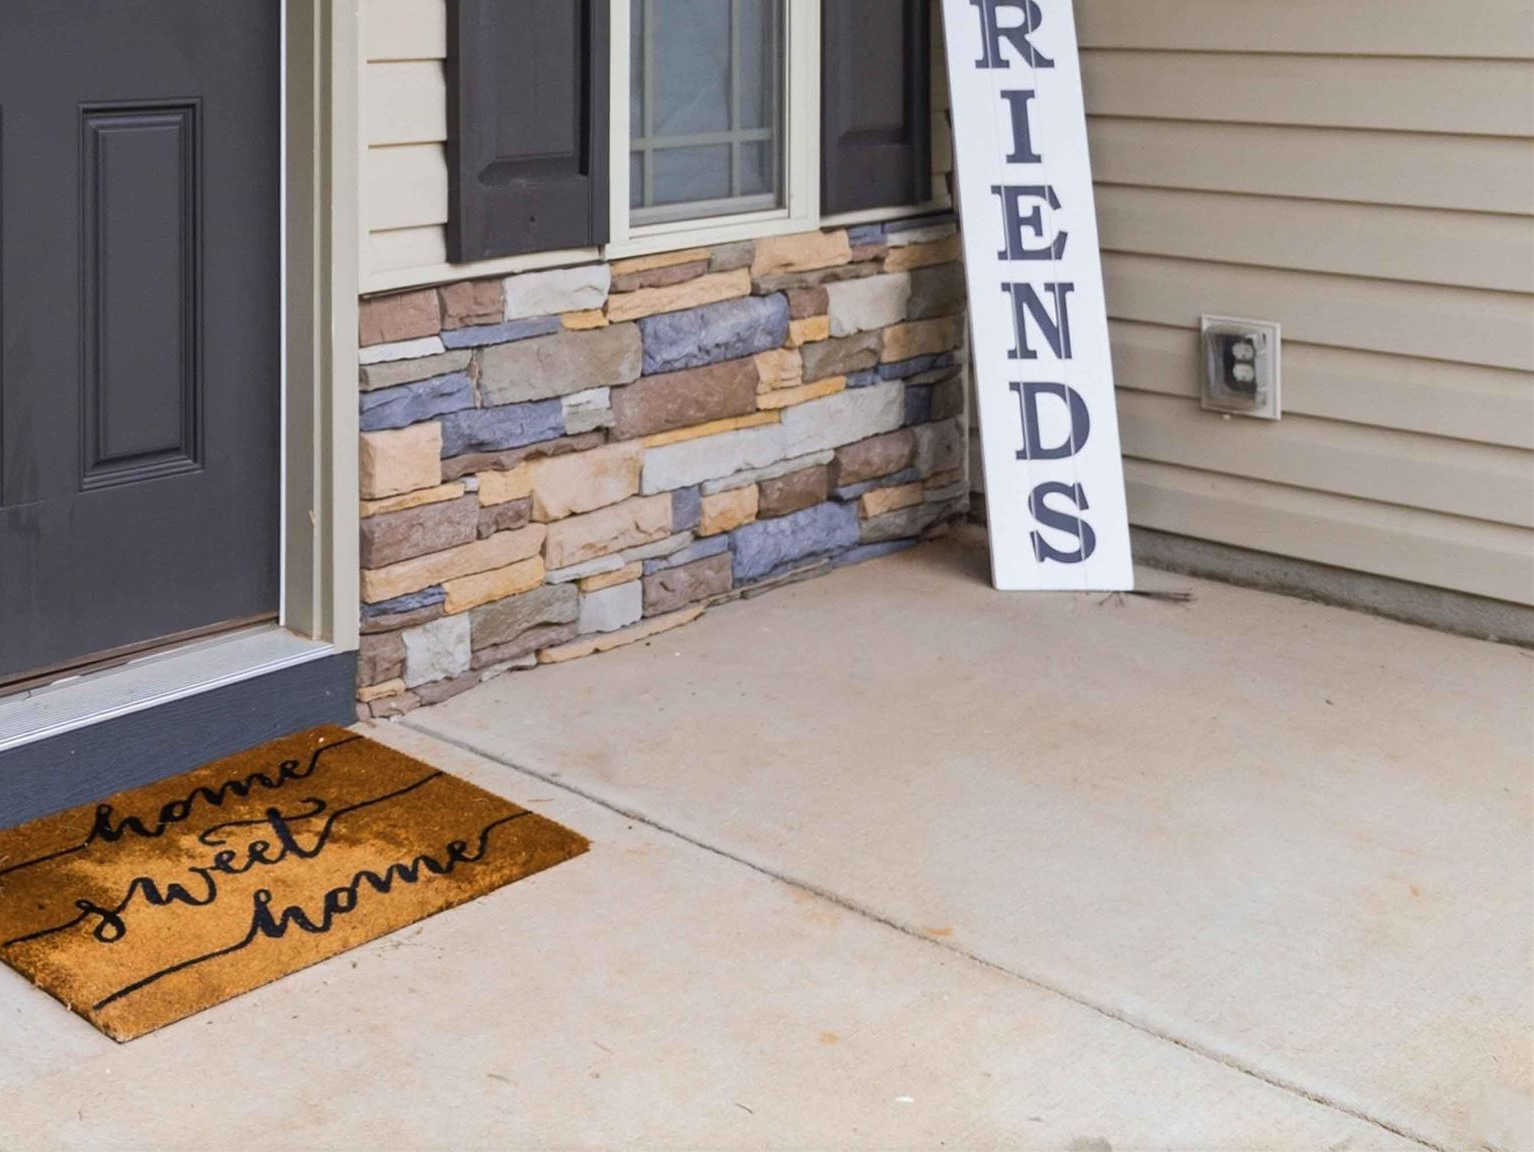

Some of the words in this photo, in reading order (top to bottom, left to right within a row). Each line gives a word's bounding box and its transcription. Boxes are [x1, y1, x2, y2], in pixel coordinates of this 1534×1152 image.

[86, 751, 322, 846] home
[75, 798, 336, 943] sweet
[250, 833, 490, 943] home
